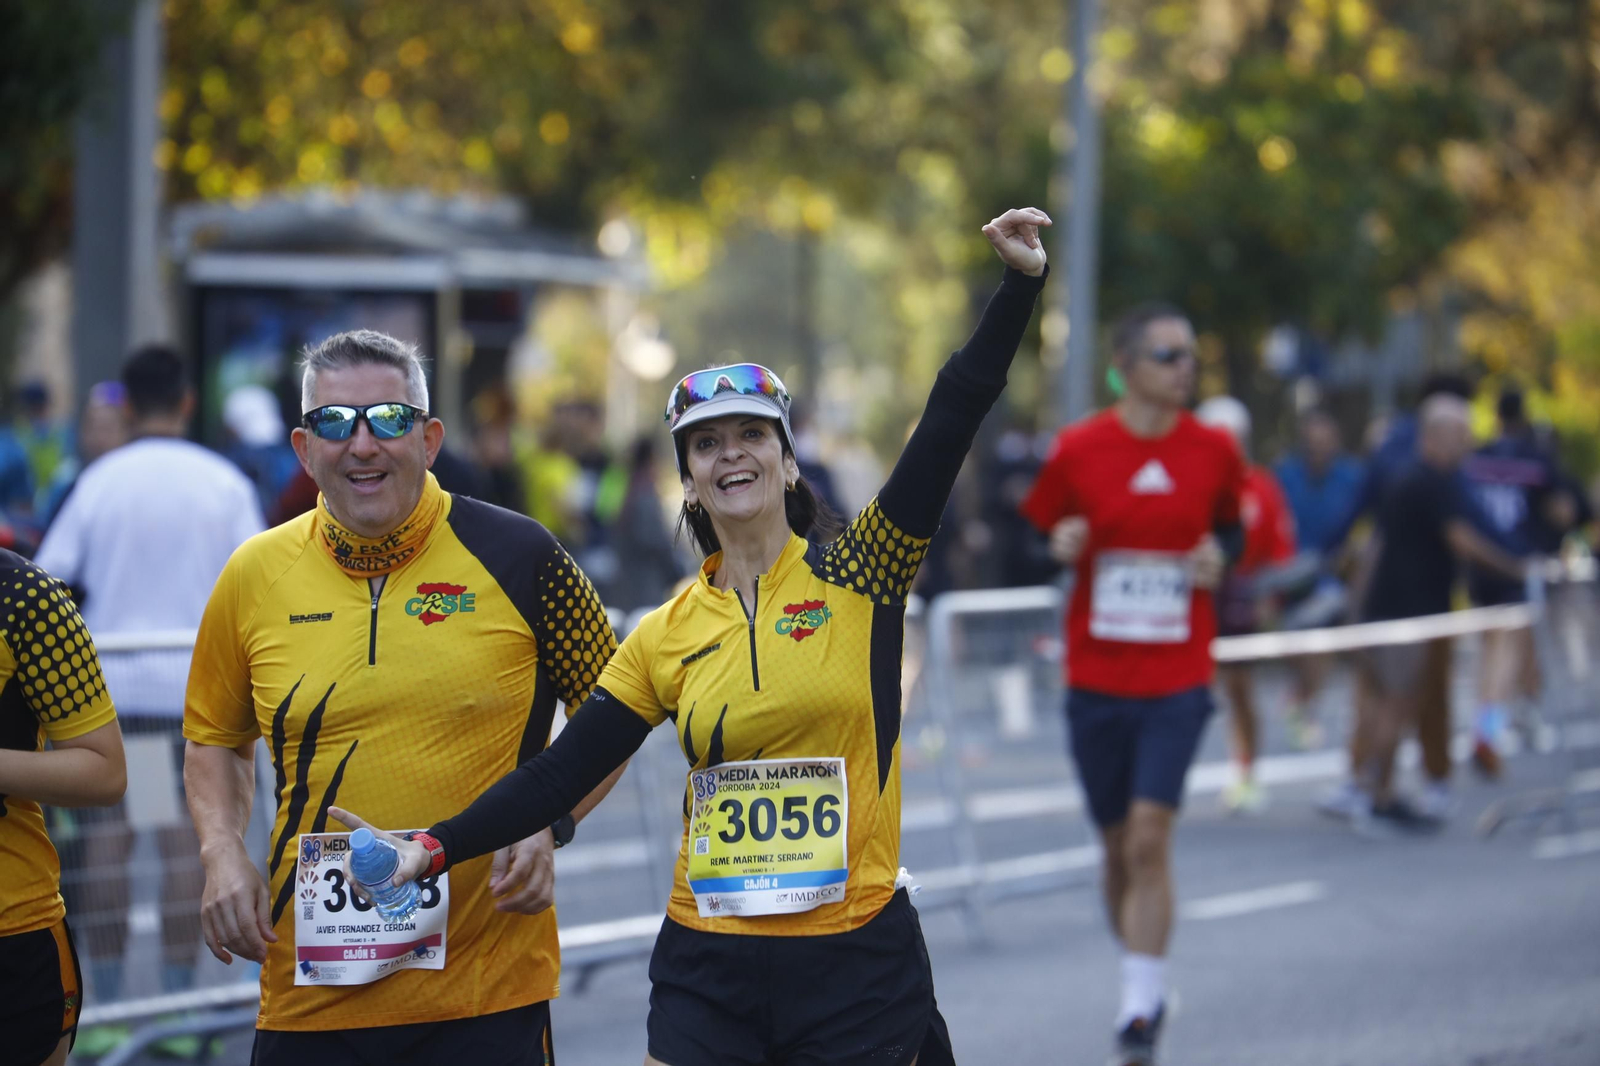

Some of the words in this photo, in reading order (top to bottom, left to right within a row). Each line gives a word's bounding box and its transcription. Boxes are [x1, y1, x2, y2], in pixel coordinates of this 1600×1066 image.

[360, 532, 404, 555] ESTE
[694, 773, 717, 798] 38
[718, 768, 760, 782] MEDIA
[766, 761, 838, 780] MARATÓN
[759, 781, 780, 790] 2024
[718, 794, 841, 844] 3056
[324, 838, 353, 851] MEDI
[710, 856, 730, 867] REME
[733, 854, 774, 864] MARTINEZ
[777, 851, 814, 862] SERRANO
[323, 868, 441, 913] 38
[744, 875, 770, 890] CAJÓN
[772, 877, 778, 888] 4
[790, 886, 836, 903] IMDECO
[315, 925, 336, 934] JAVIER
[338, 924, 381, 934] FERNANDEZ
[383, 922, 416, 932] CERDAN
[343, 946, 368, 960] CAJÓN
[370, 948, 377, 959] 5
